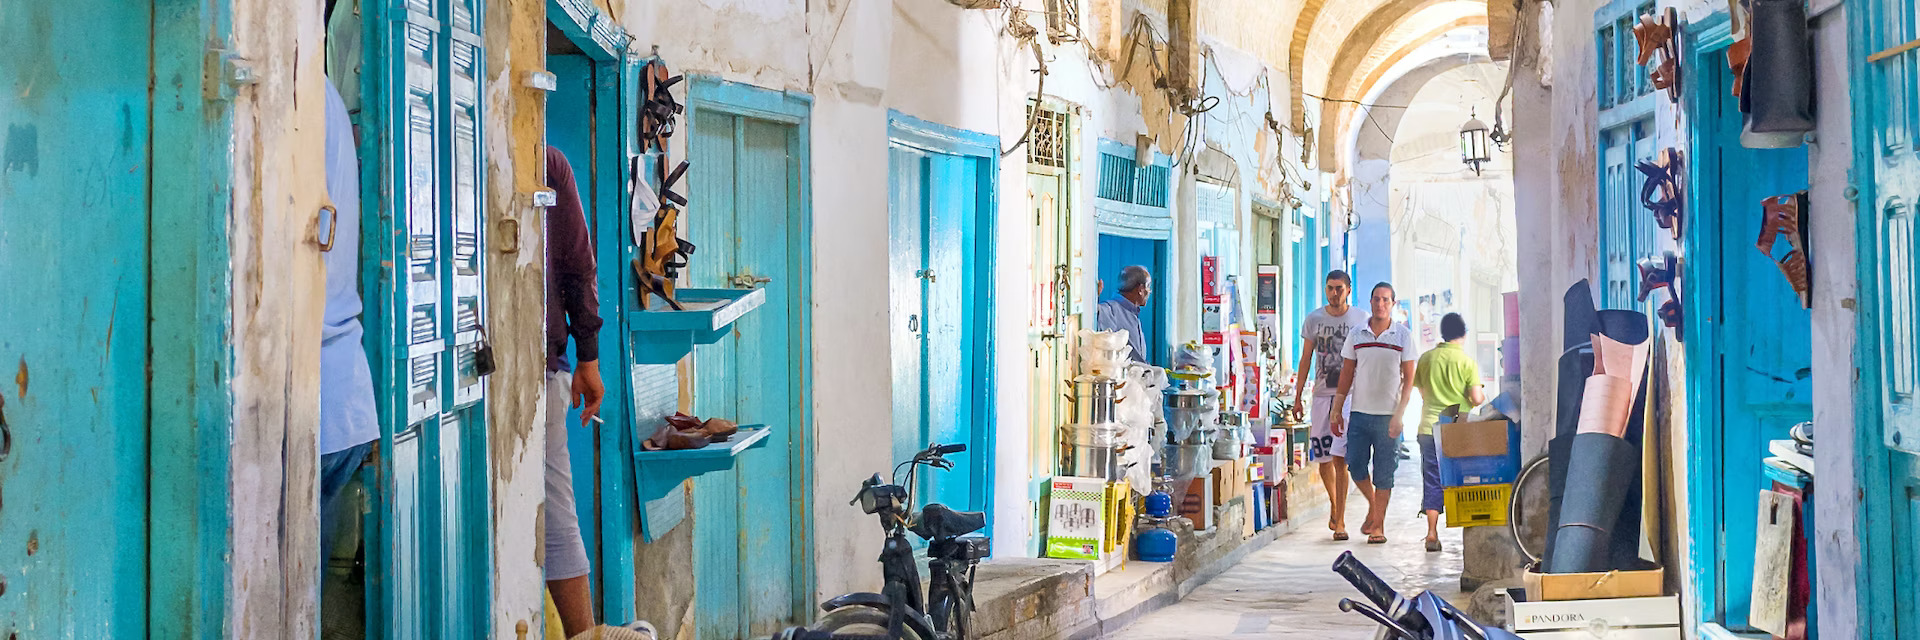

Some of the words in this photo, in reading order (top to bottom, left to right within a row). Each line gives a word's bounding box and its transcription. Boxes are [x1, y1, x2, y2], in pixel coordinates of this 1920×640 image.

[1317, 323, 1335, 335] I'm
[1338, 322, 1354, 335] th
[1532, 613, 1585, 624] PANDORA
